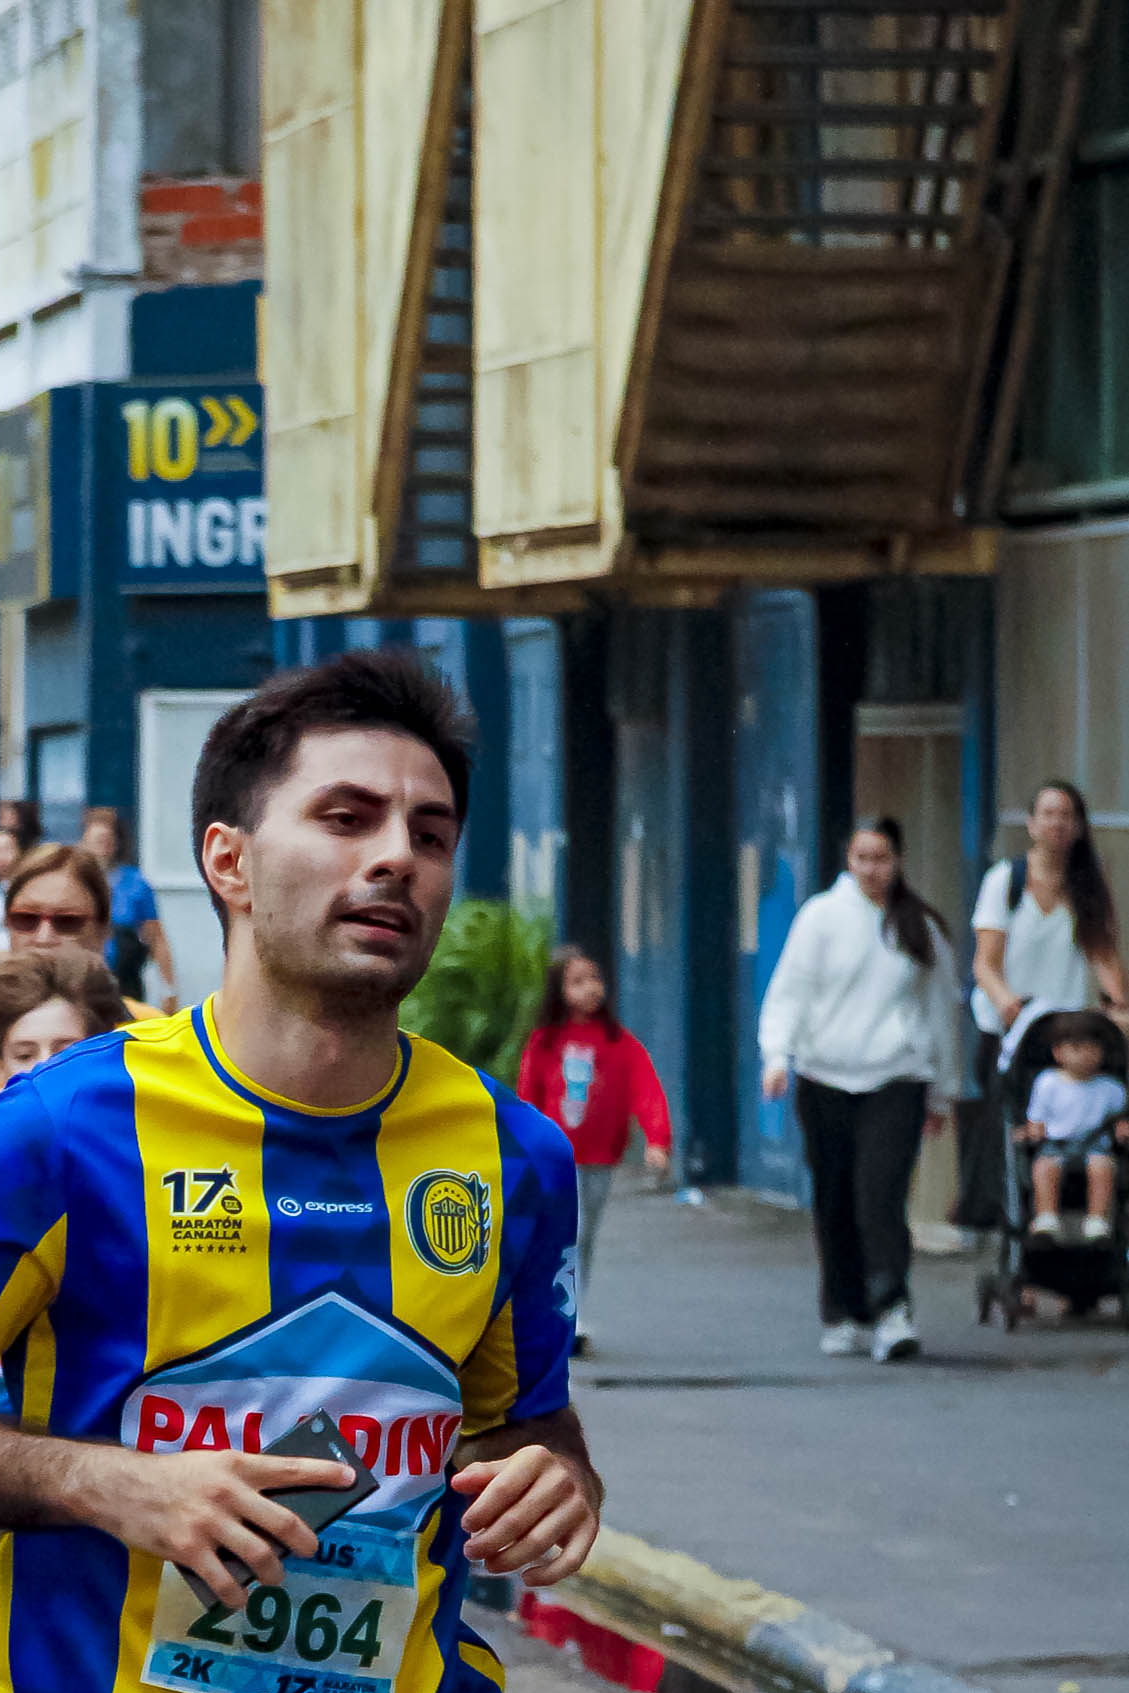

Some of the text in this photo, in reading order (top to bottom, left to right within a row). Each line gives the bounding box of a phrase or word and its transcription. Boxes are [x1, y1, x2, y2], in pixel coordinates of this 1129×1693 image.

[122, 398, 199, 481] 10
[127, 497, 269, 568] INGR
[171, 1216, 242, 1229] MARATÓN
[305, 1201, 373, 1214] express
[173, 1230, 241, 1240] CANALLA
[186, 1585, 383, 1668] 2964
[170, 1652, 214, 1684] 2K
